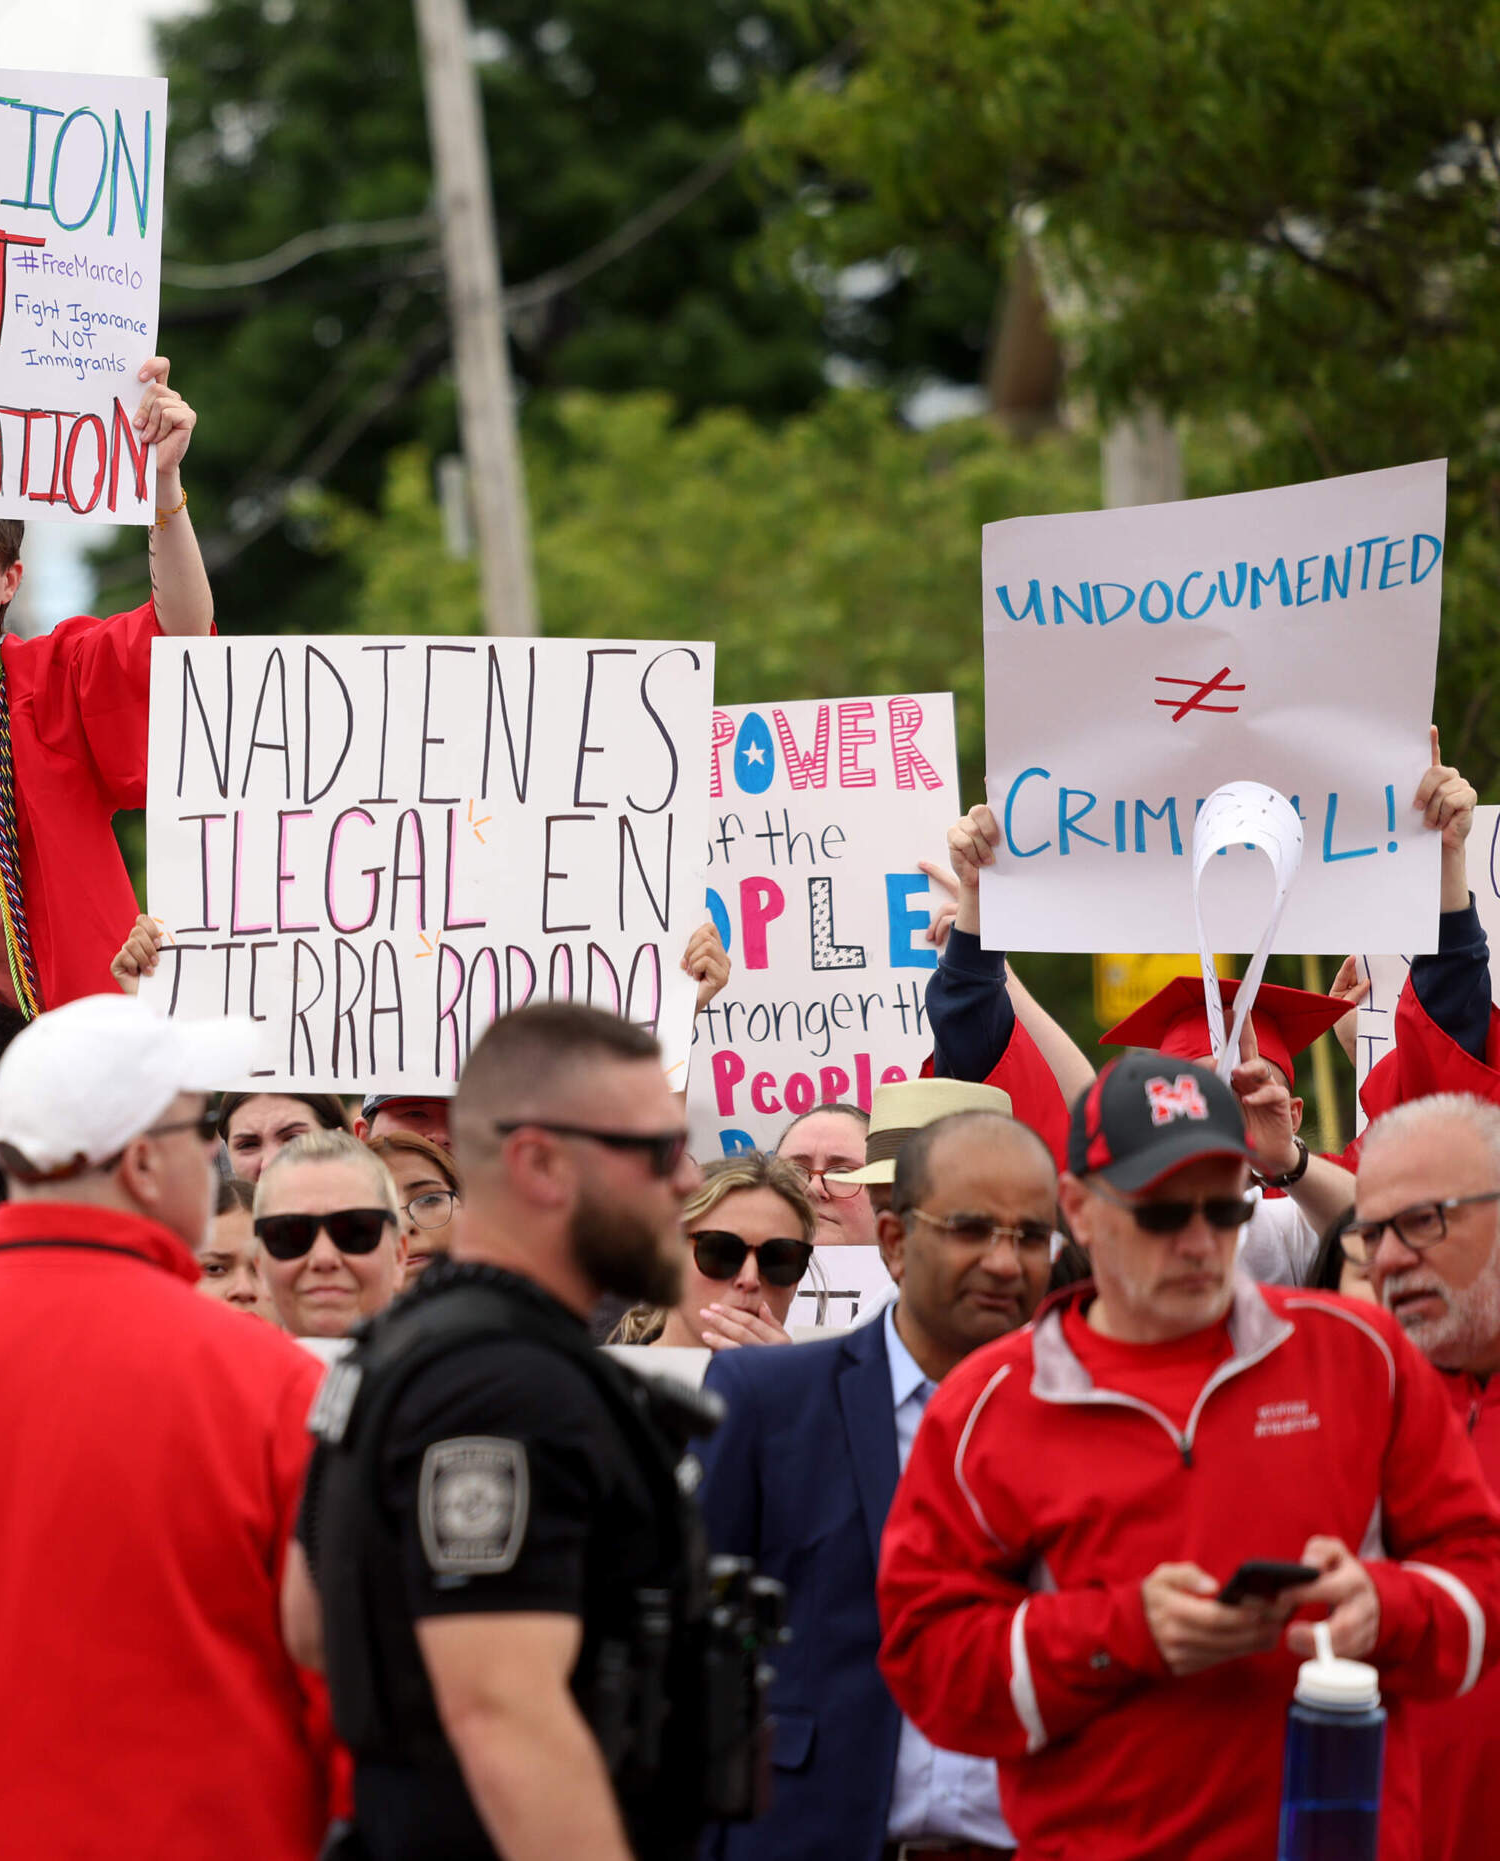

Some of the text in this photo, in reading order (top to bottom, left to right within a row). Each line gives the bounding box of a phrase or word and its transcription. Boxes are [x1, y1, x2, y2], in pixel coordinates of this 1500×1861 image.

[11, 249, 143, 290] #FreeMarcelo
[14, 294, 148, 336] Fight Ignorance
[52, 329, 98, 350] NOT
[21, 349, 126, 380] Immigrants
[995, 533, 1443, 627] UNDOCUMENTED
[573, 647, 702, 814] ES
[710, 696, 944, 798] POWER
[707, 807, 847, 867] f the
[1003, 766, 1399, 864] CRIML!
[175, 806, 675, 939] ILEGAL EN
